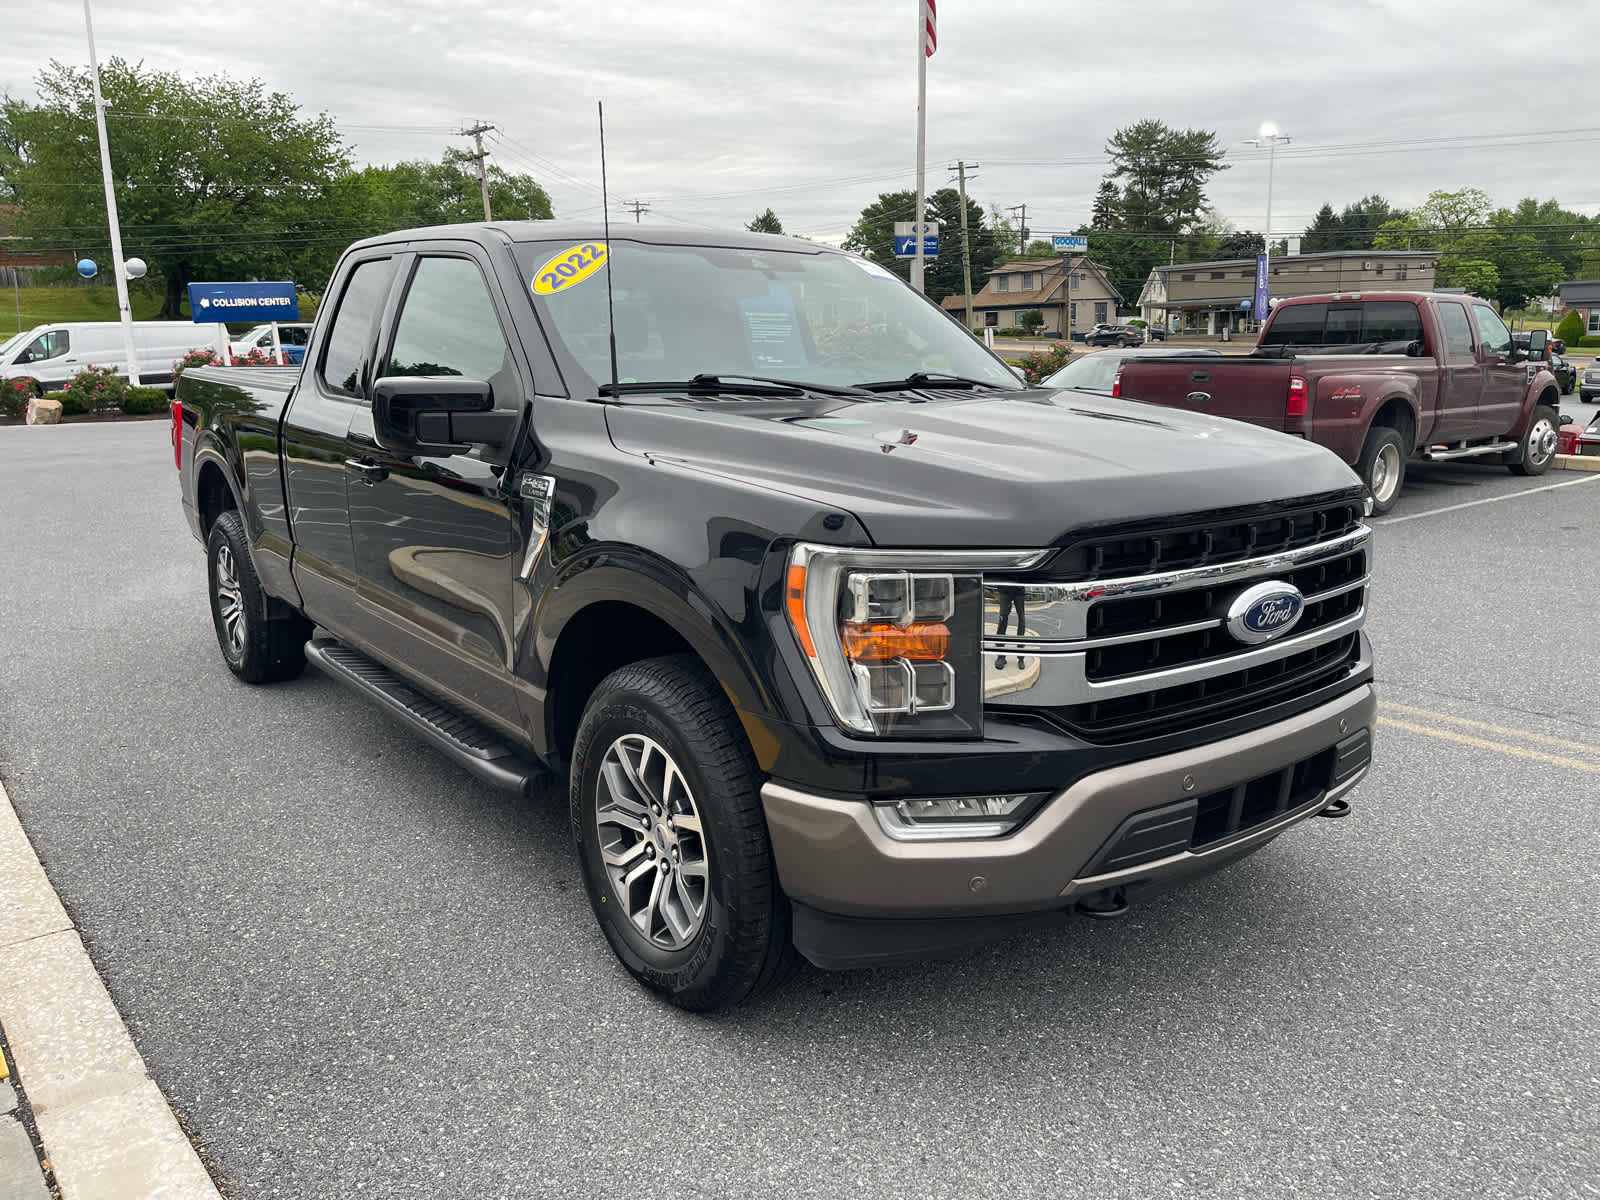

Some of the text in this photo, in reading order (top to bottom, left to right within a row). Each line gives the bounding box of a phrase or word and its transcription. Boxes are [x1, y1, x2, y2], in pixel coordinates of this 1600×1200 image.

[541, 245, 605, 289] 2022
[212, 297, 291, 307] COLLISION CENTER
[1257, 599, 1293, 627] Ford
